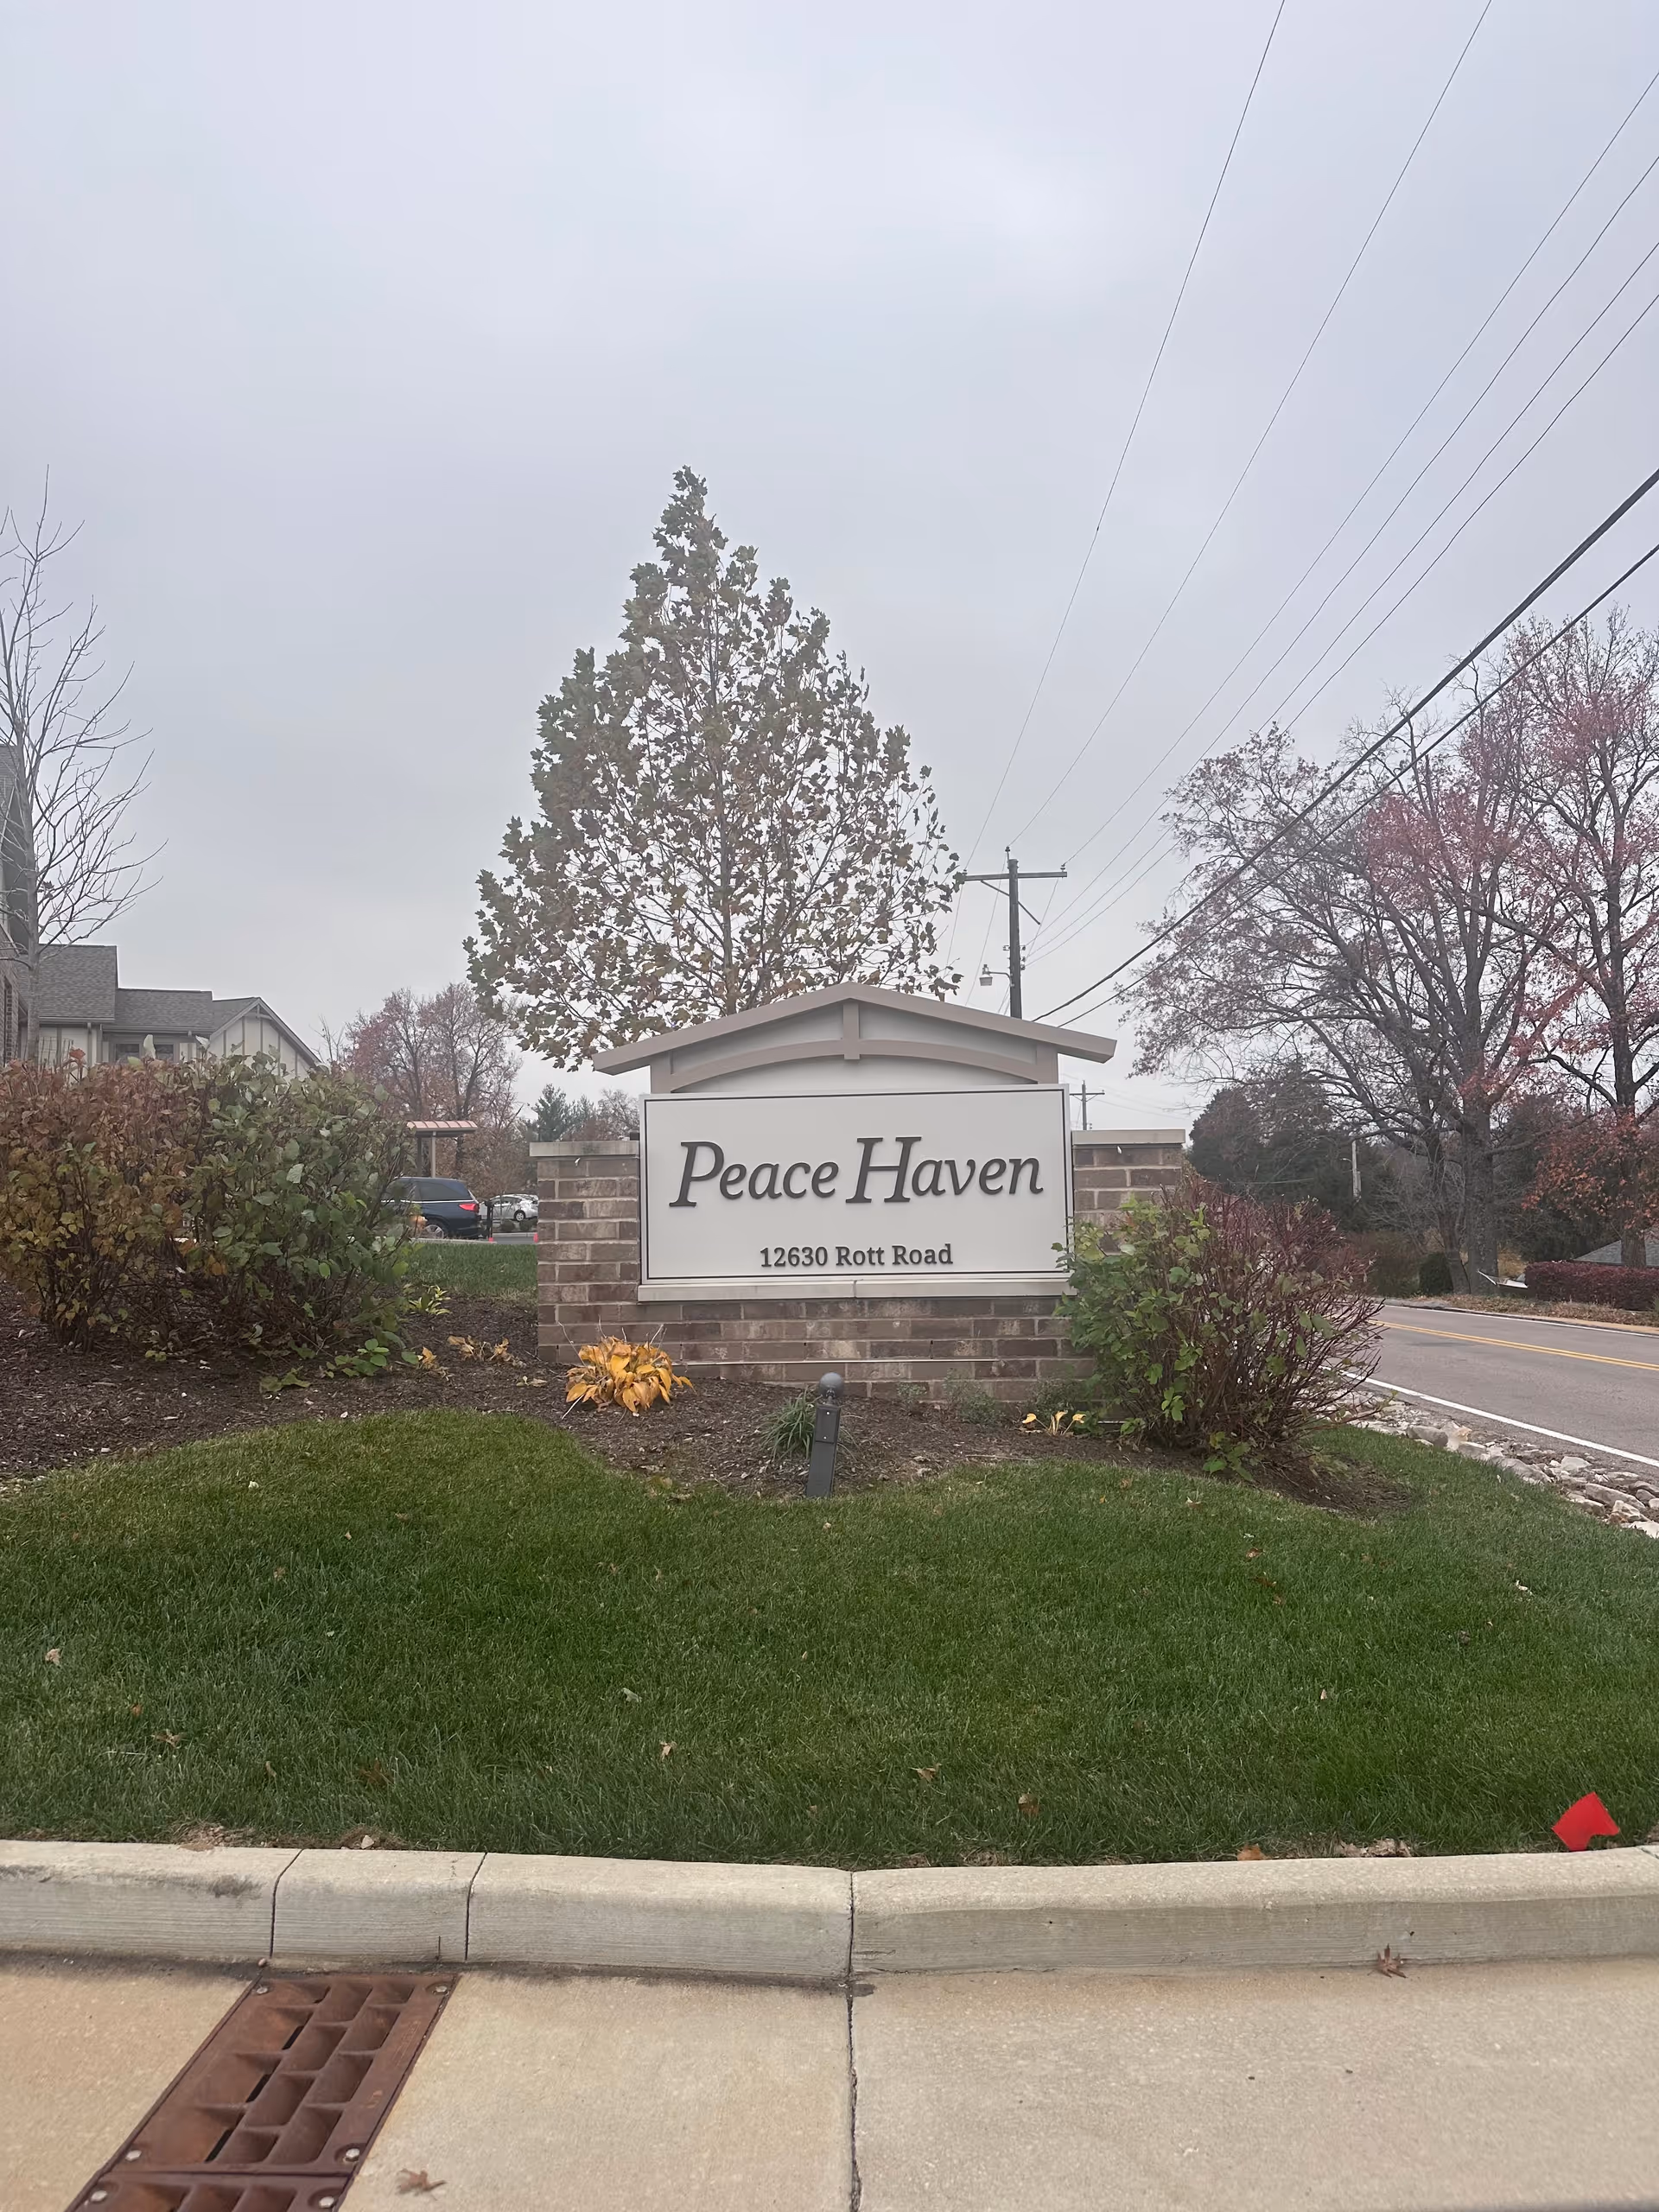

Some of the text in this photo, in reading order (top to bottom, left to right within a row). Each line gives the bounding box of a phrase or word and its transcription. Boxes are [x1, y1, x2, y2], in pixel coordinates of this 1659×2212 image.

[668, 1136, 1044, 1208] Peace Haven
[760, 1243, 954, 1268] 12630 Rott Road
